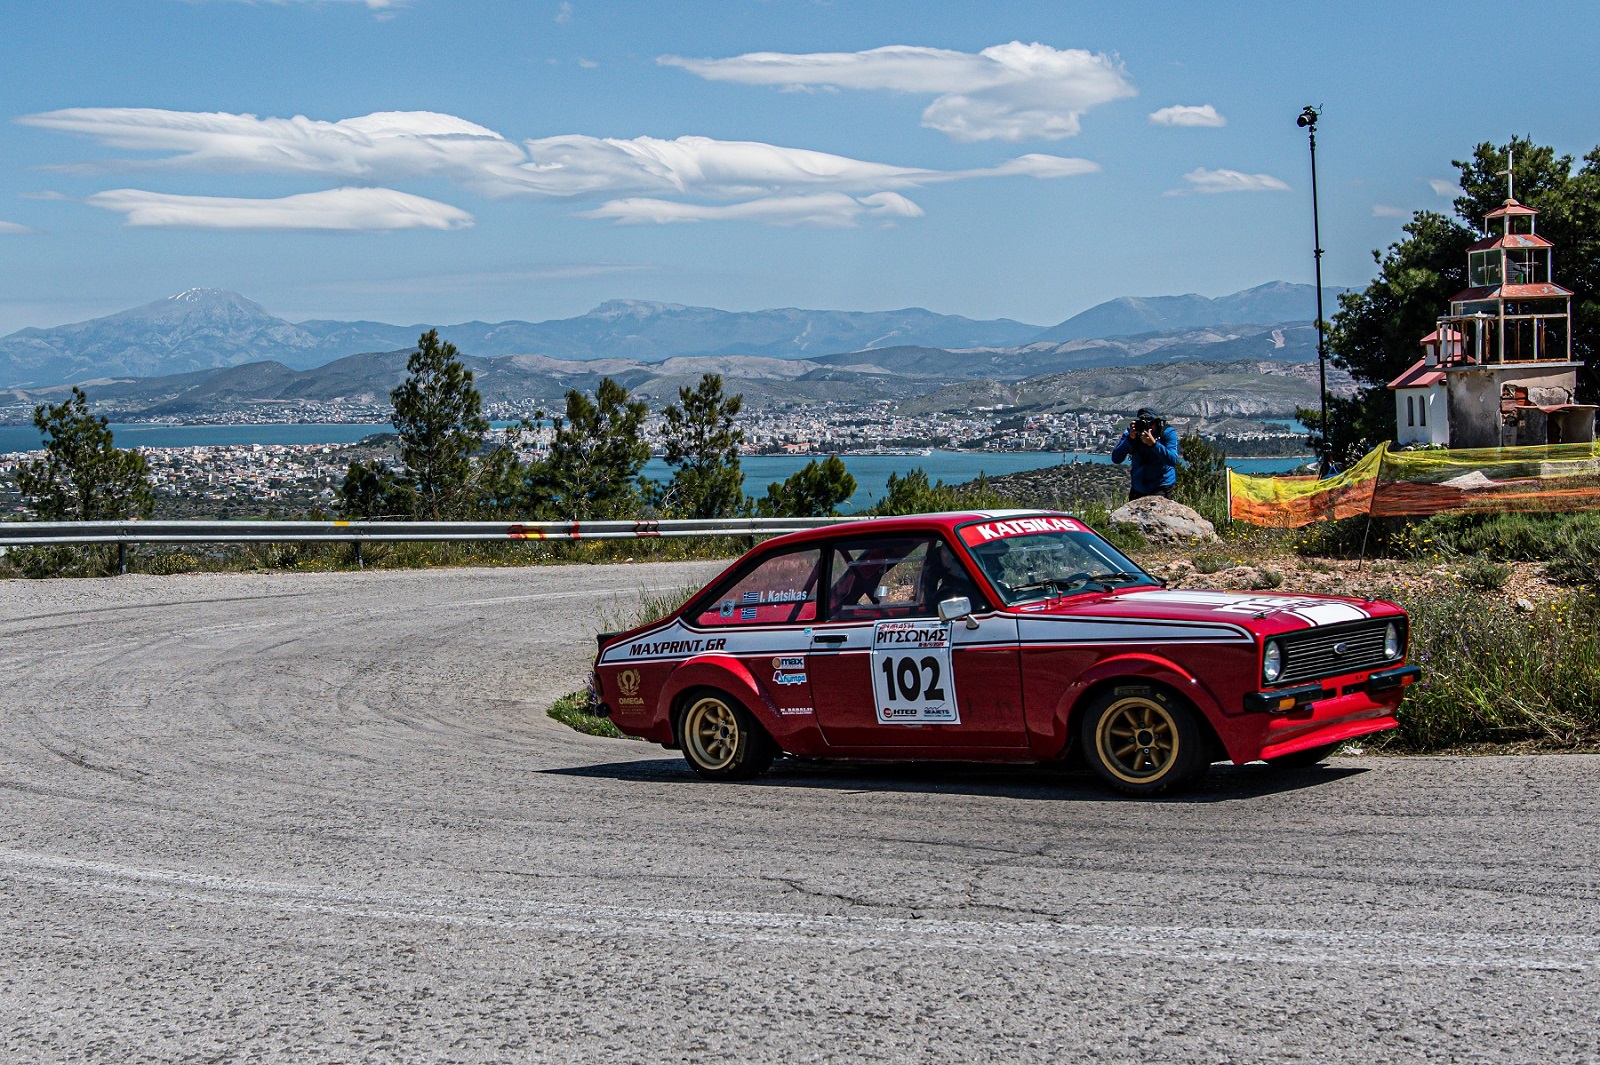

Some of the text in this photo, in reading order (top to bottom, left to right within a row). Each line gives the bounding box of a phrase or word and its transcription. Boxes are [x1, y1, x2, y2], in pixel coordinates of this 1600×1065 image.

[976, 518, 1079, 540] KATSIKAS
[768, 588, 808, 603] Katsikas
[877, 628, 949, 644] ΡΙΤΣΩΝΑΣ
[629, 638, 727, 657] MAXPRINT.GR
[882, 655, 946, 702] 102
[618, 697, 645, 705] OMEGA
